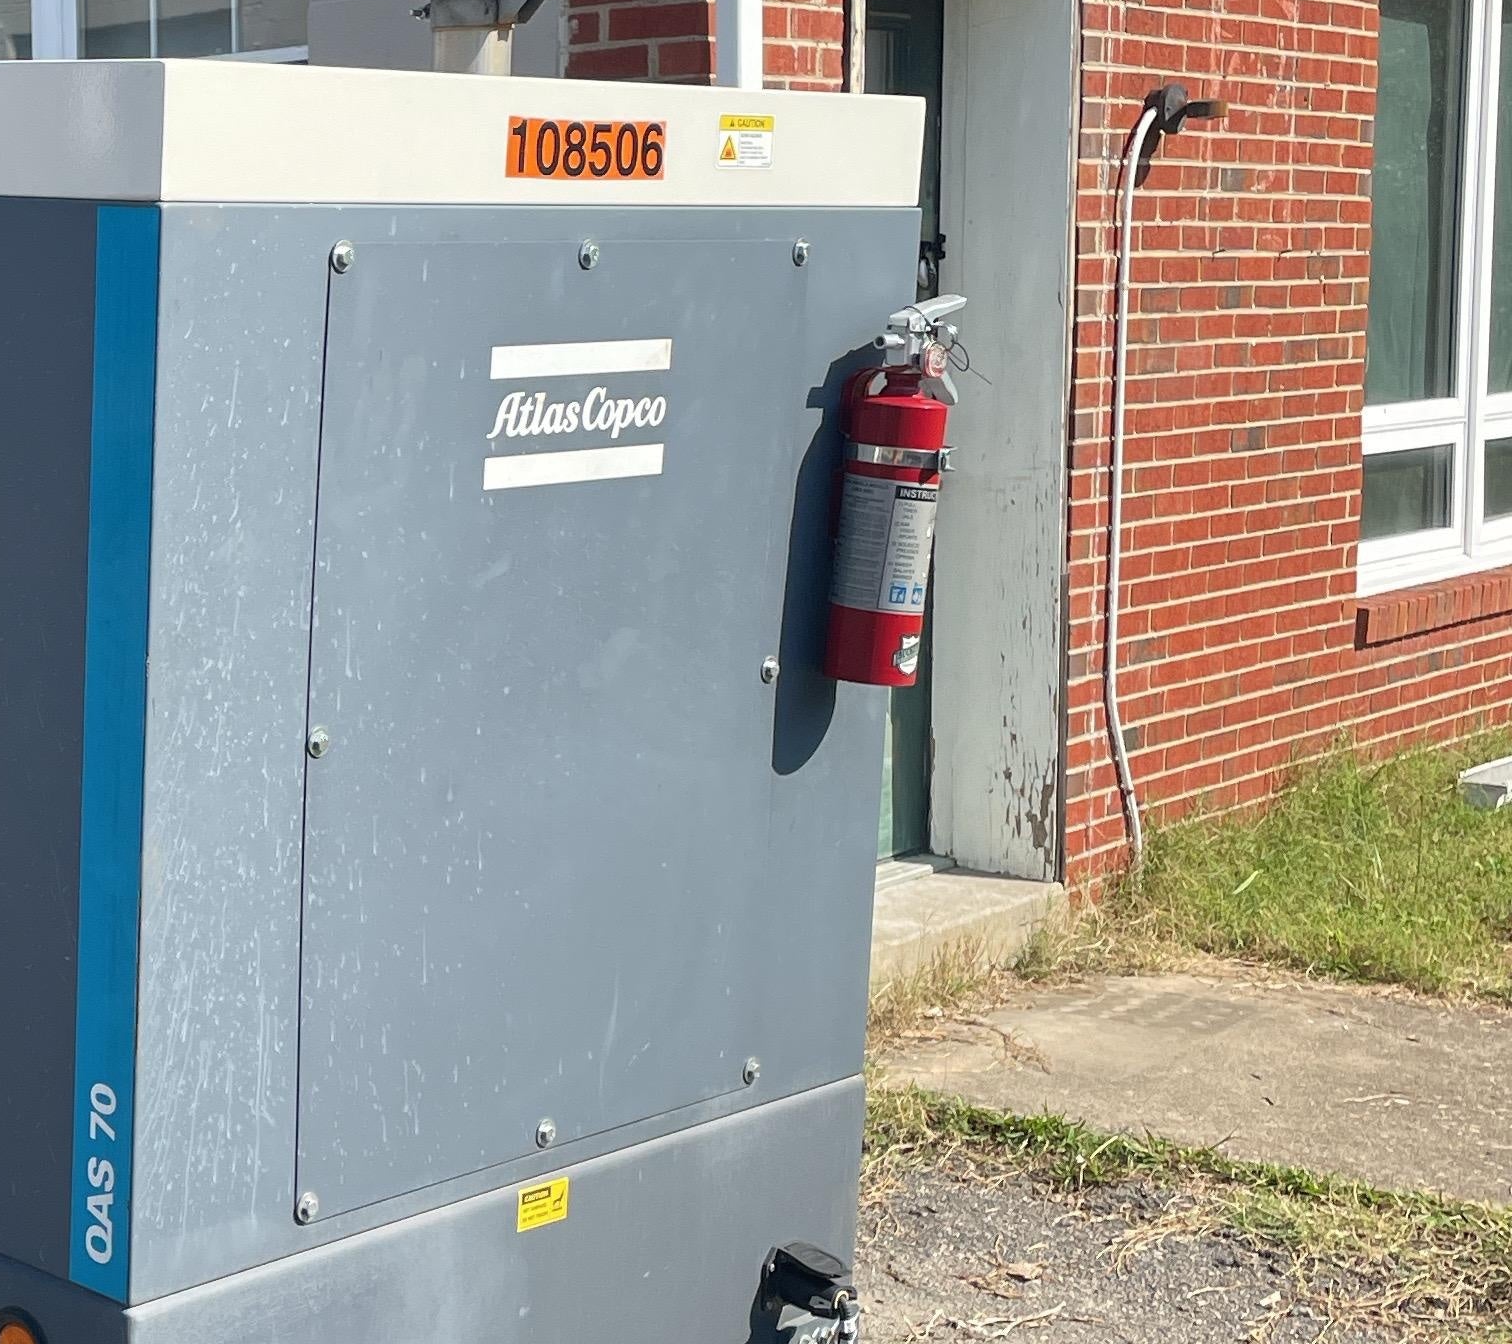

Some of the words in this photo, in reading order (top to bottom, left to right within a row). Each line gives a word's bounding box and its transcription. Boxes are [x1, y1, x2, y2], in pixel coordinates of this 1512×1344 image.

[512, 119, 664, 177] 108506
[486, 391, 580, 439] Atlas
[582, 386, 667, 439] Copco
[89, 1083, 116, 1141] 70
[85, 1156, 115, 1265] QAS
